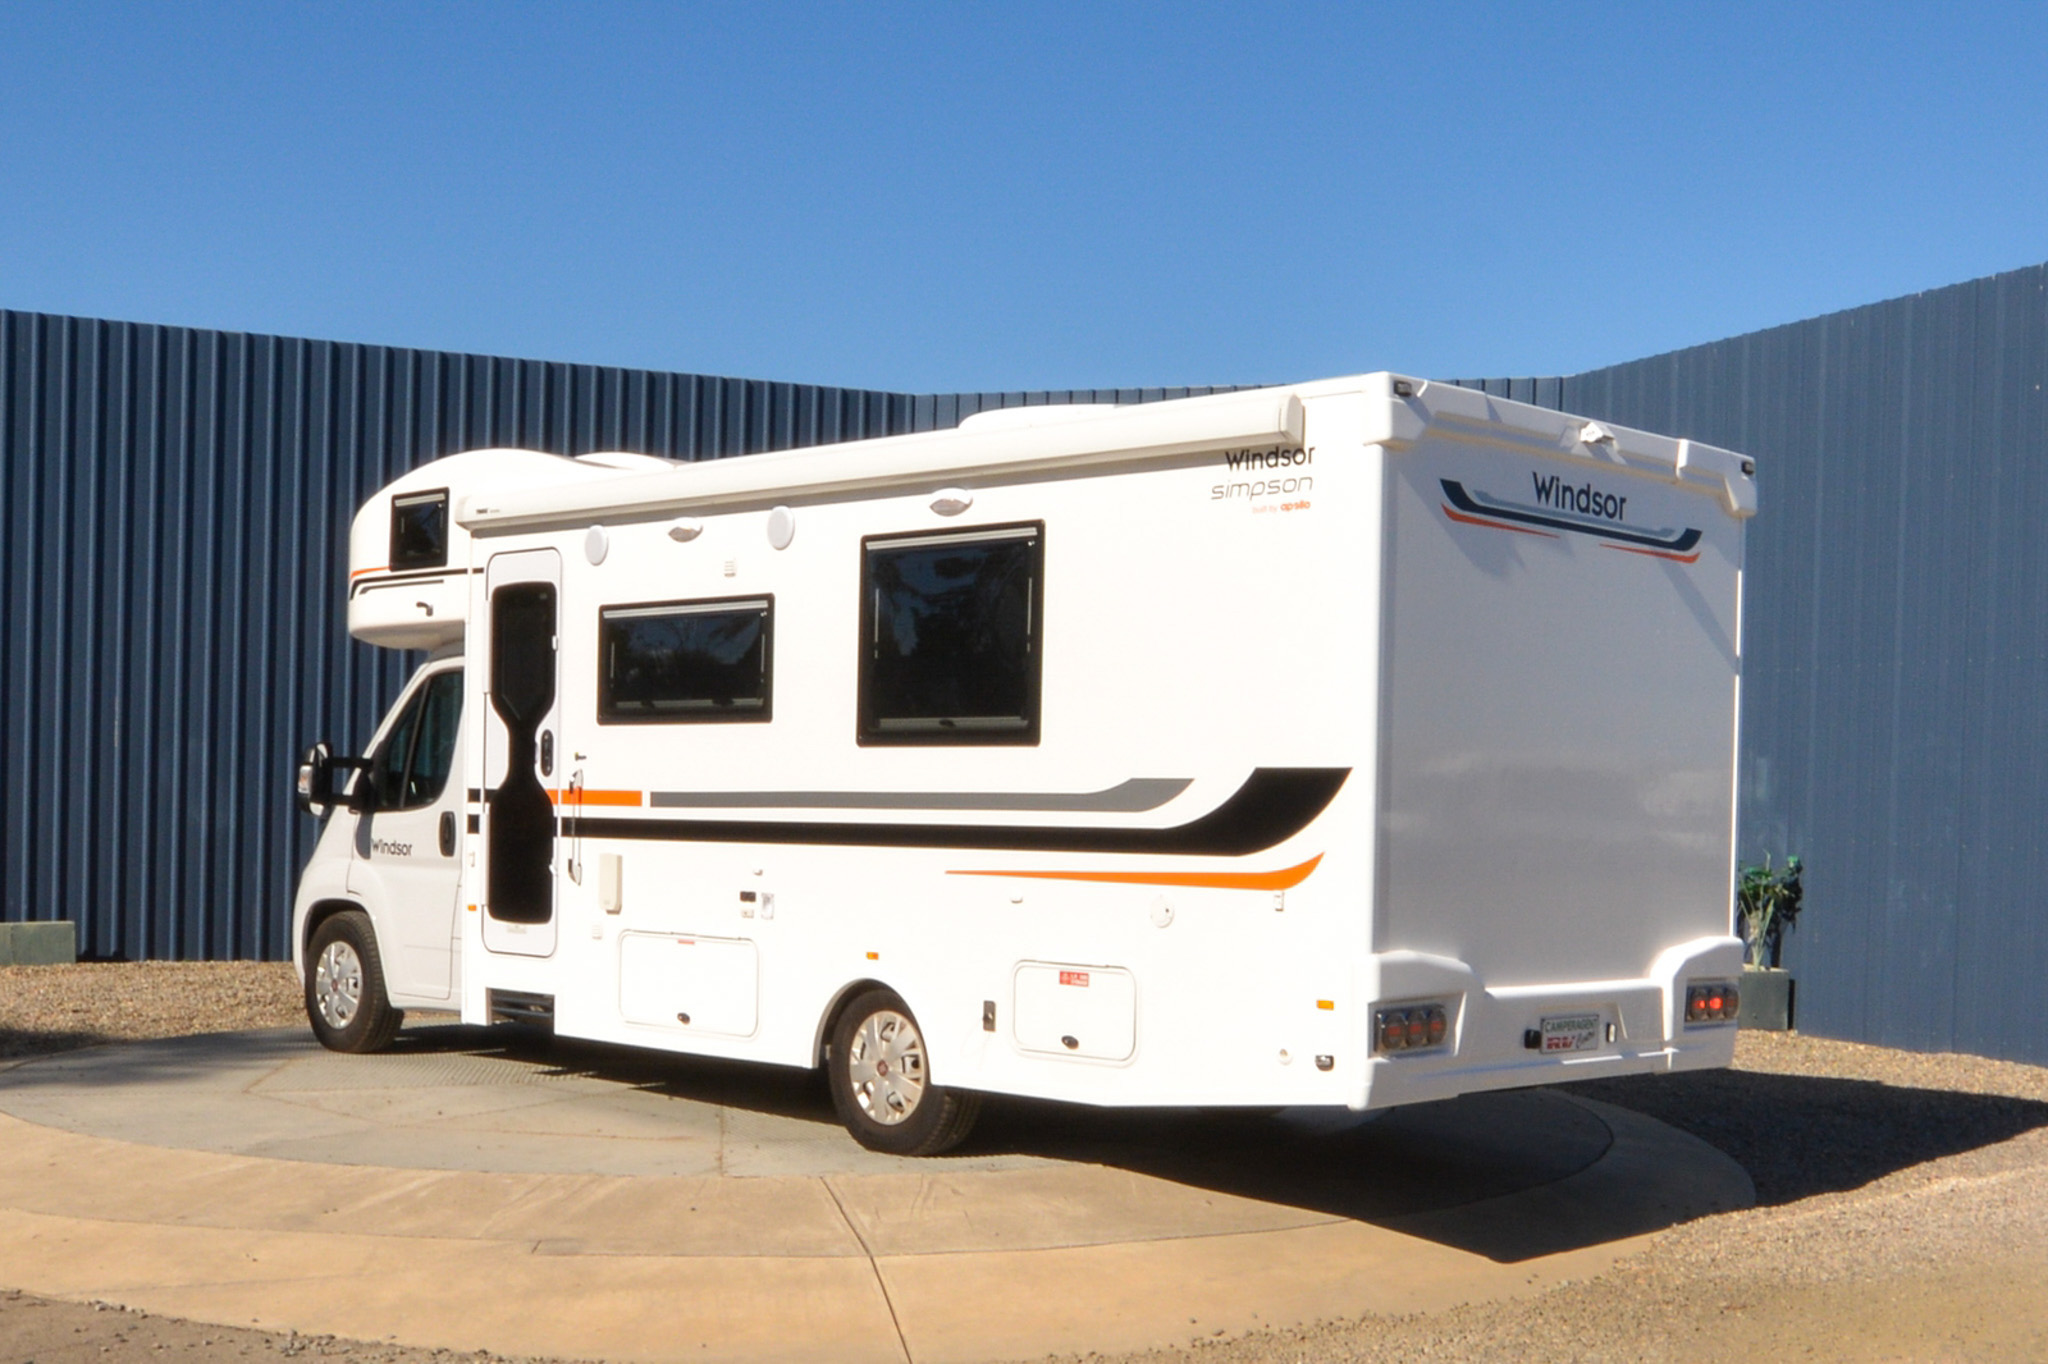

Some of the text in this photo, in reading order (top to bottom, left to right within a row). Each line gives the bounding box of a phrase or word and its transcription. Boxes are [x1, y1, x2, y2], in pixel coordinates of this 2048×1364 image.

[1225, 446, 1316, 471] Windsor
[1210, 476, 1313, 501] simpson
[1532, 471, 1627, 521] Windsor
[370, 838, 413, 856] Windsor
